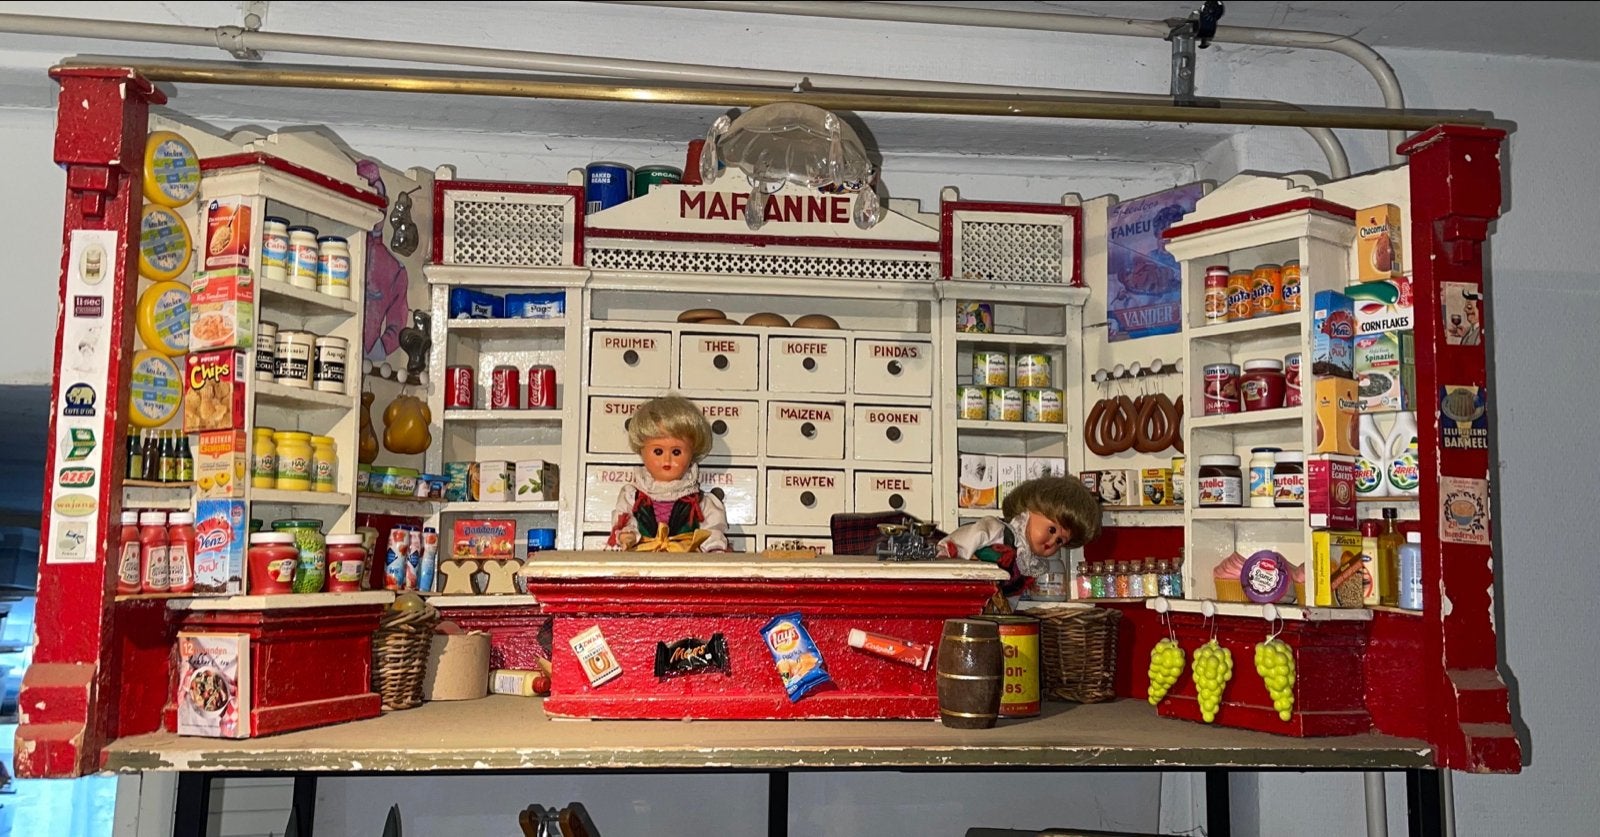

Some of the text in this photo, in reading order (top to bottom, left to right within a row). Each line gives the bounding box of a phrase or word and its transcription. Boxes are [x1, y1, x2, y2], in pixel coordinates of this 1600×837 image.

[680, 190, 850, 224] MARANNE
[1361, 316, 1409, 333] CORN FLAKES
[704, 341, 736, 352] THEE
[786, 343, 828, 355] KOFFIE
[874, 345, 918, 358] PINDA'S
[1364, 353, 1395, 363] Spinazie
[190, 361, 231, 389] Chips
[780, 409, 832, 421] MAIZENA
[869, 412, 919, 424] BOONEN
[1443, 436, 1489, 449] BAKMEEL
[60, 470, 94, 485] AZET
[785, 477, 835, 489] ERWTEN
[876, 479, 911, 491] MEEL
[199, 532, 222, 549] Venz
[183, 643, 194, 654] 12
